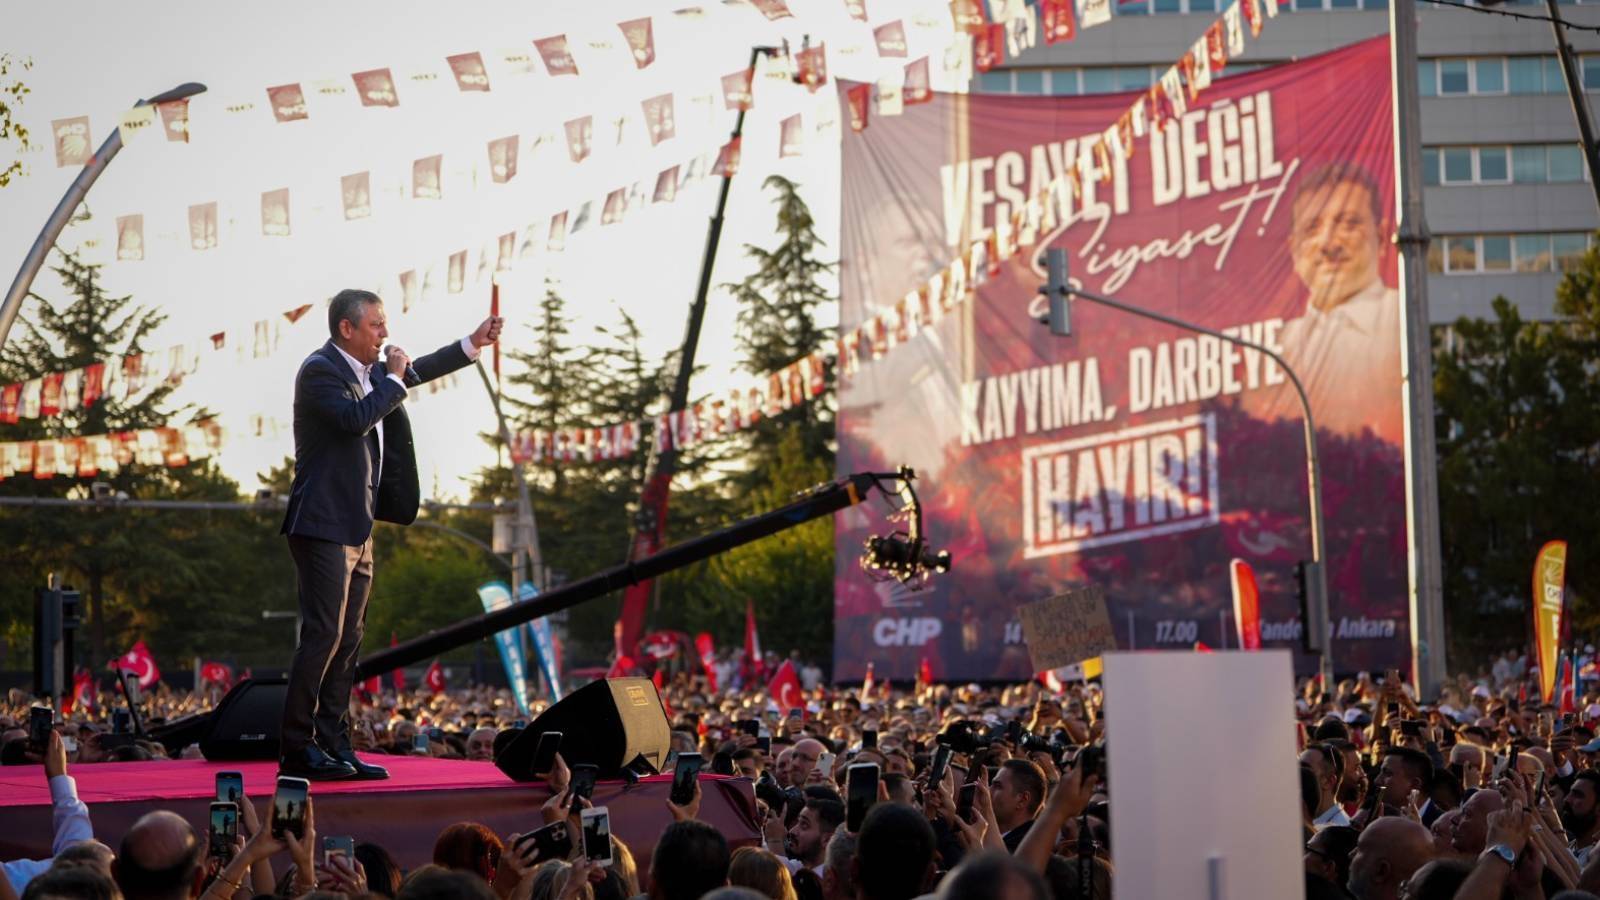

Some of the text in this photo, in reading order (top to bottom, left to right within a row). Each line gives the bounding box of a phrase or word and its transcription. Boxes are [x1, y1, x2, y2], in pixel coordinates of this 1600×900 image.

[940, 125, 1129, 246] VESAYET
[961, 318, 1284, 446] KAYYIMA, DARBEYE
[1037, 428, 1203, 543] HAYIR!
[873, 616, 942, 647] CHP
[1155, 620, 1198, 643] 17.00
[1337, 616, 1396, 638] Ankara
